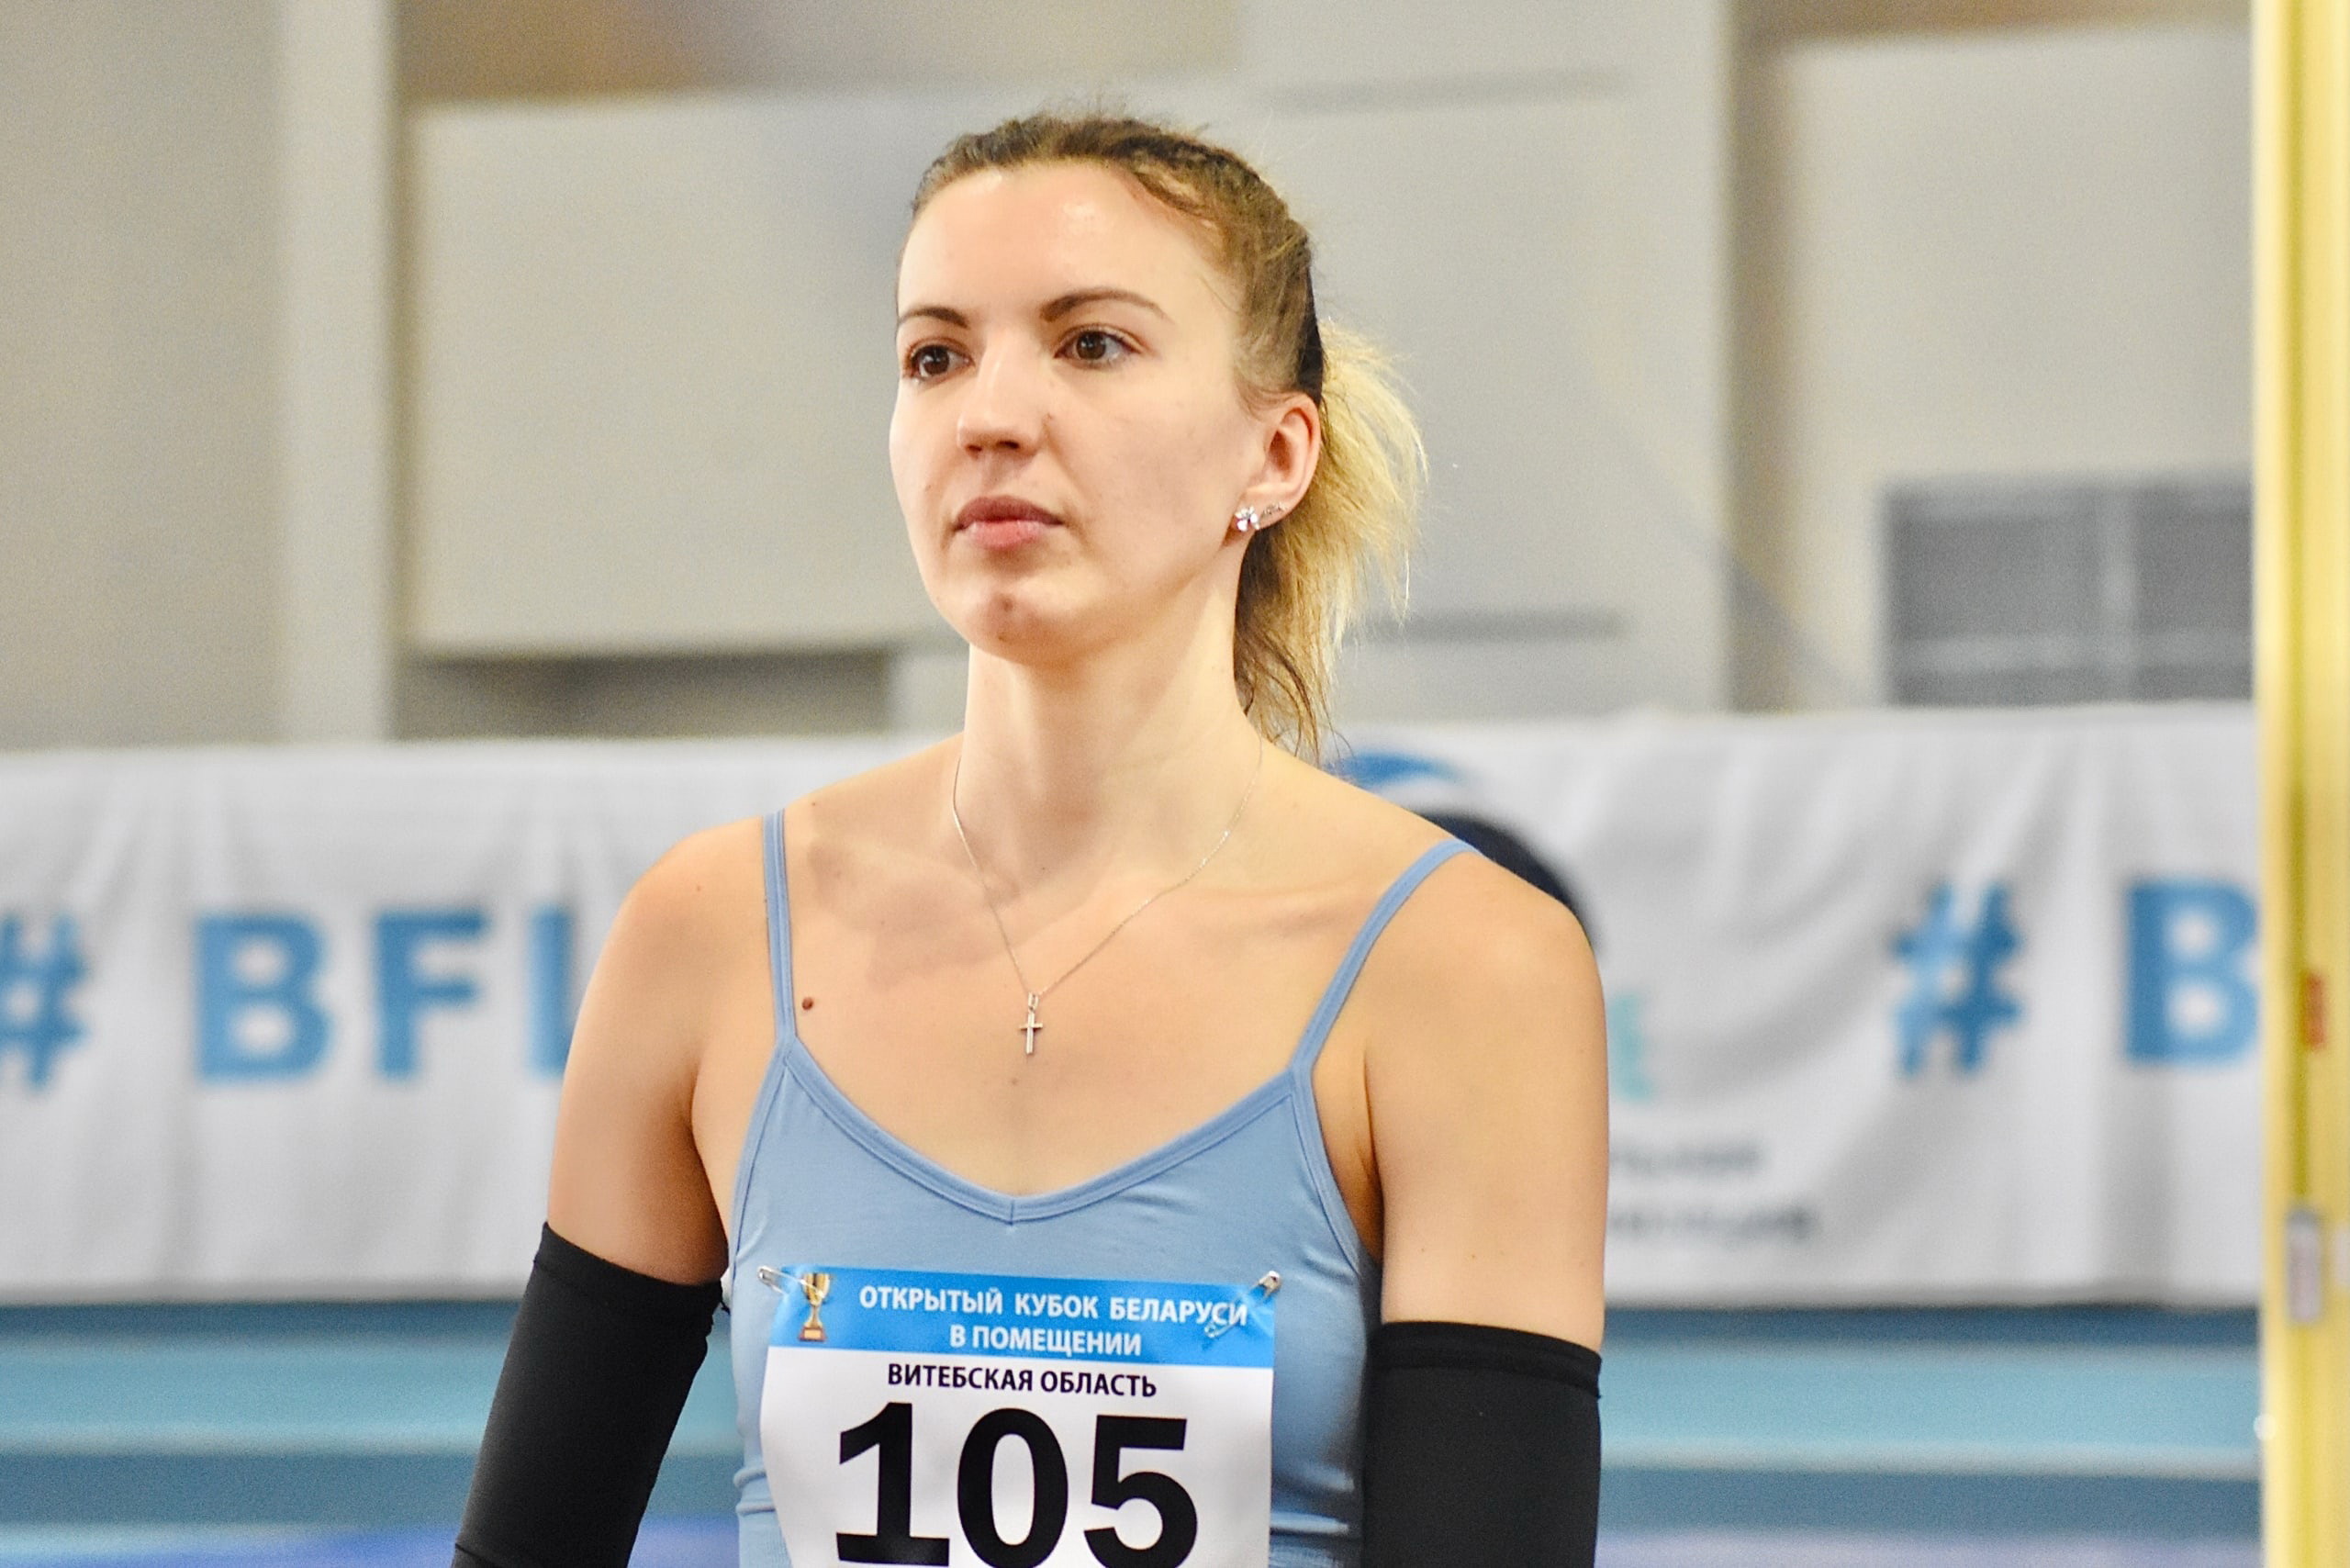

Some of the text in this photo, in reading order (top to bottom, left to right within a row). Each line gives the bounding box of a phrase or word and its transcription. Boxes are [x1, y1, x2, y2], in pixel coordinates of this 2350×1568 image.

[859, 1285, 1247, 1326] ОТКРЫТЫЙ КУБОК БЕЛАРУСИ
[950, 1325, 1142, 1356] В ПОМЕЩЕНИИ
[887, 1362, 1157, 1397] ВИТЕБСКАЯ ОБЛАСТЬ
[835, 1401, 1198, 1568] 105
